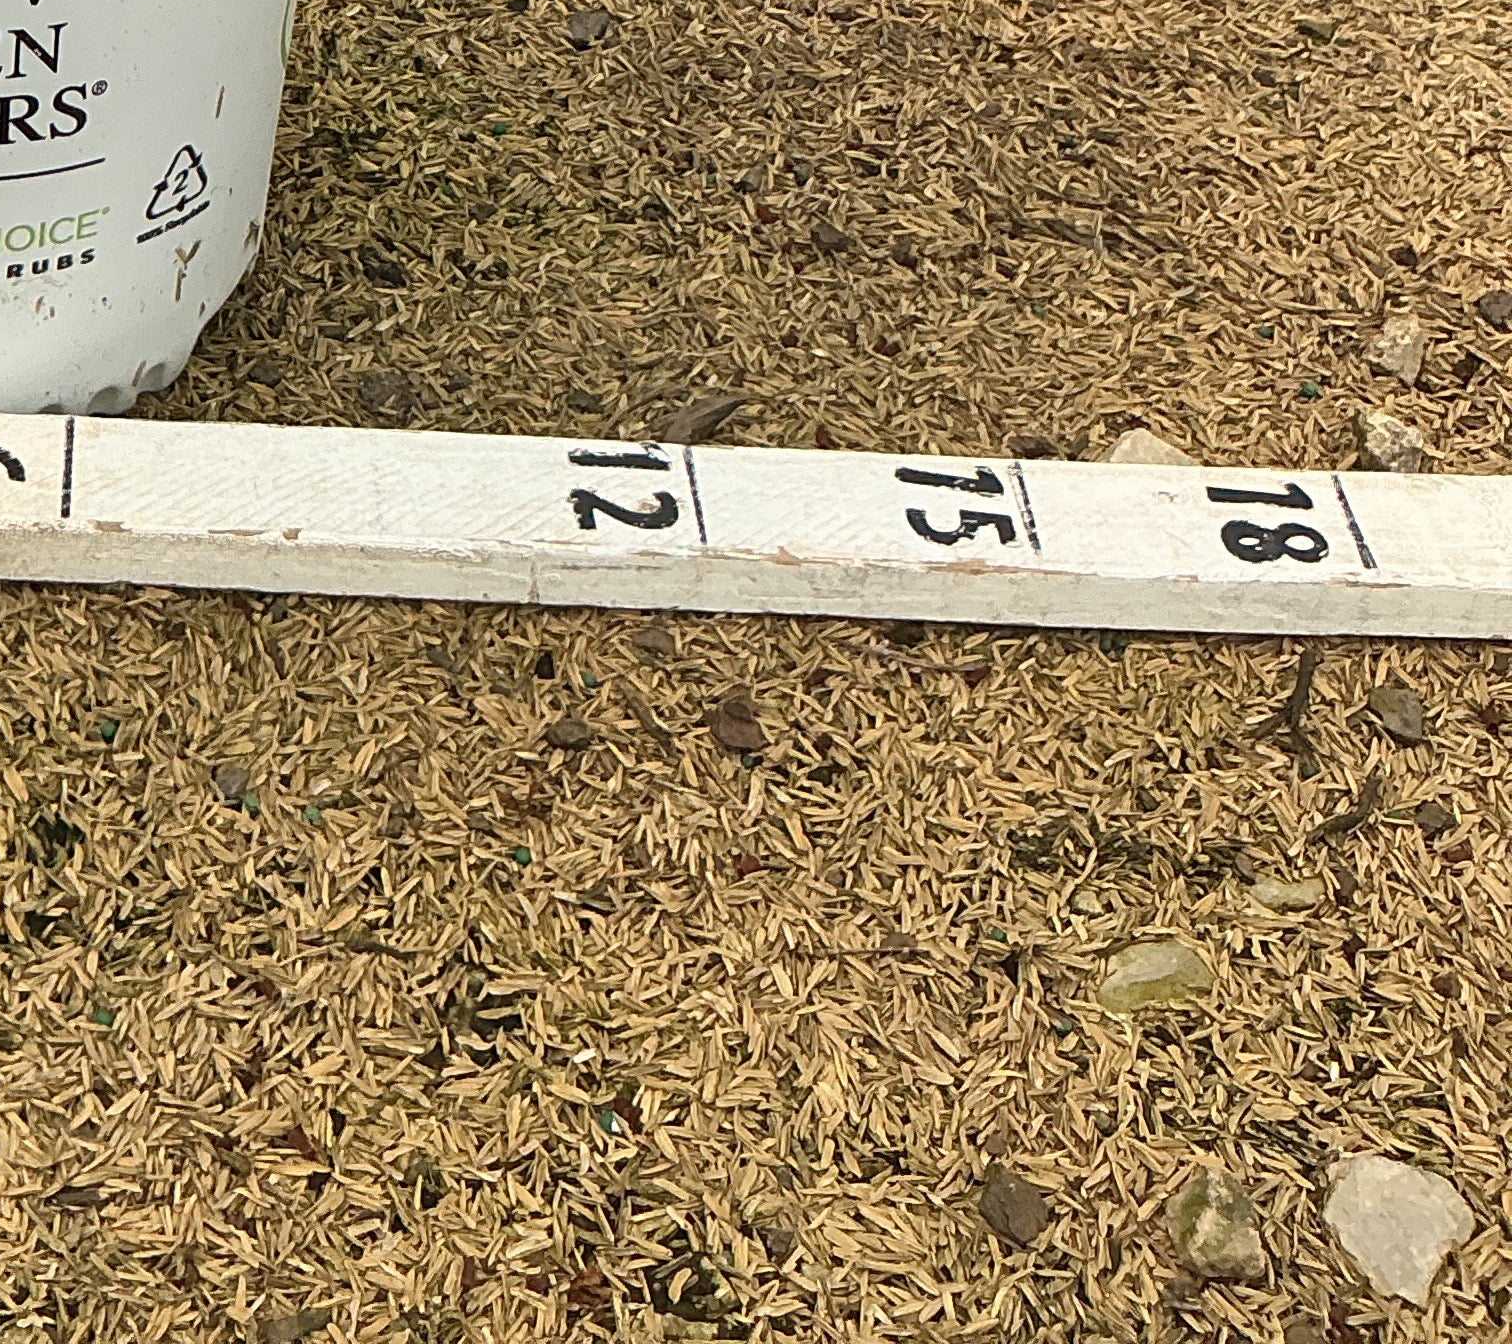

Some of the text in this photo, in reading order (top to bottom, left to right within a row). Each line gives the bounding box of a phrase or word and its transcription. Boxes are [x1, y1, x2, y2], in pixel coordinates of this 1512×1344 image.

[172, 169, 189, 196] 2
[567, 443, 680, 530] 12
[894, 465, 1020, 545] 15
[1205, 482, 1330, 564] 18
